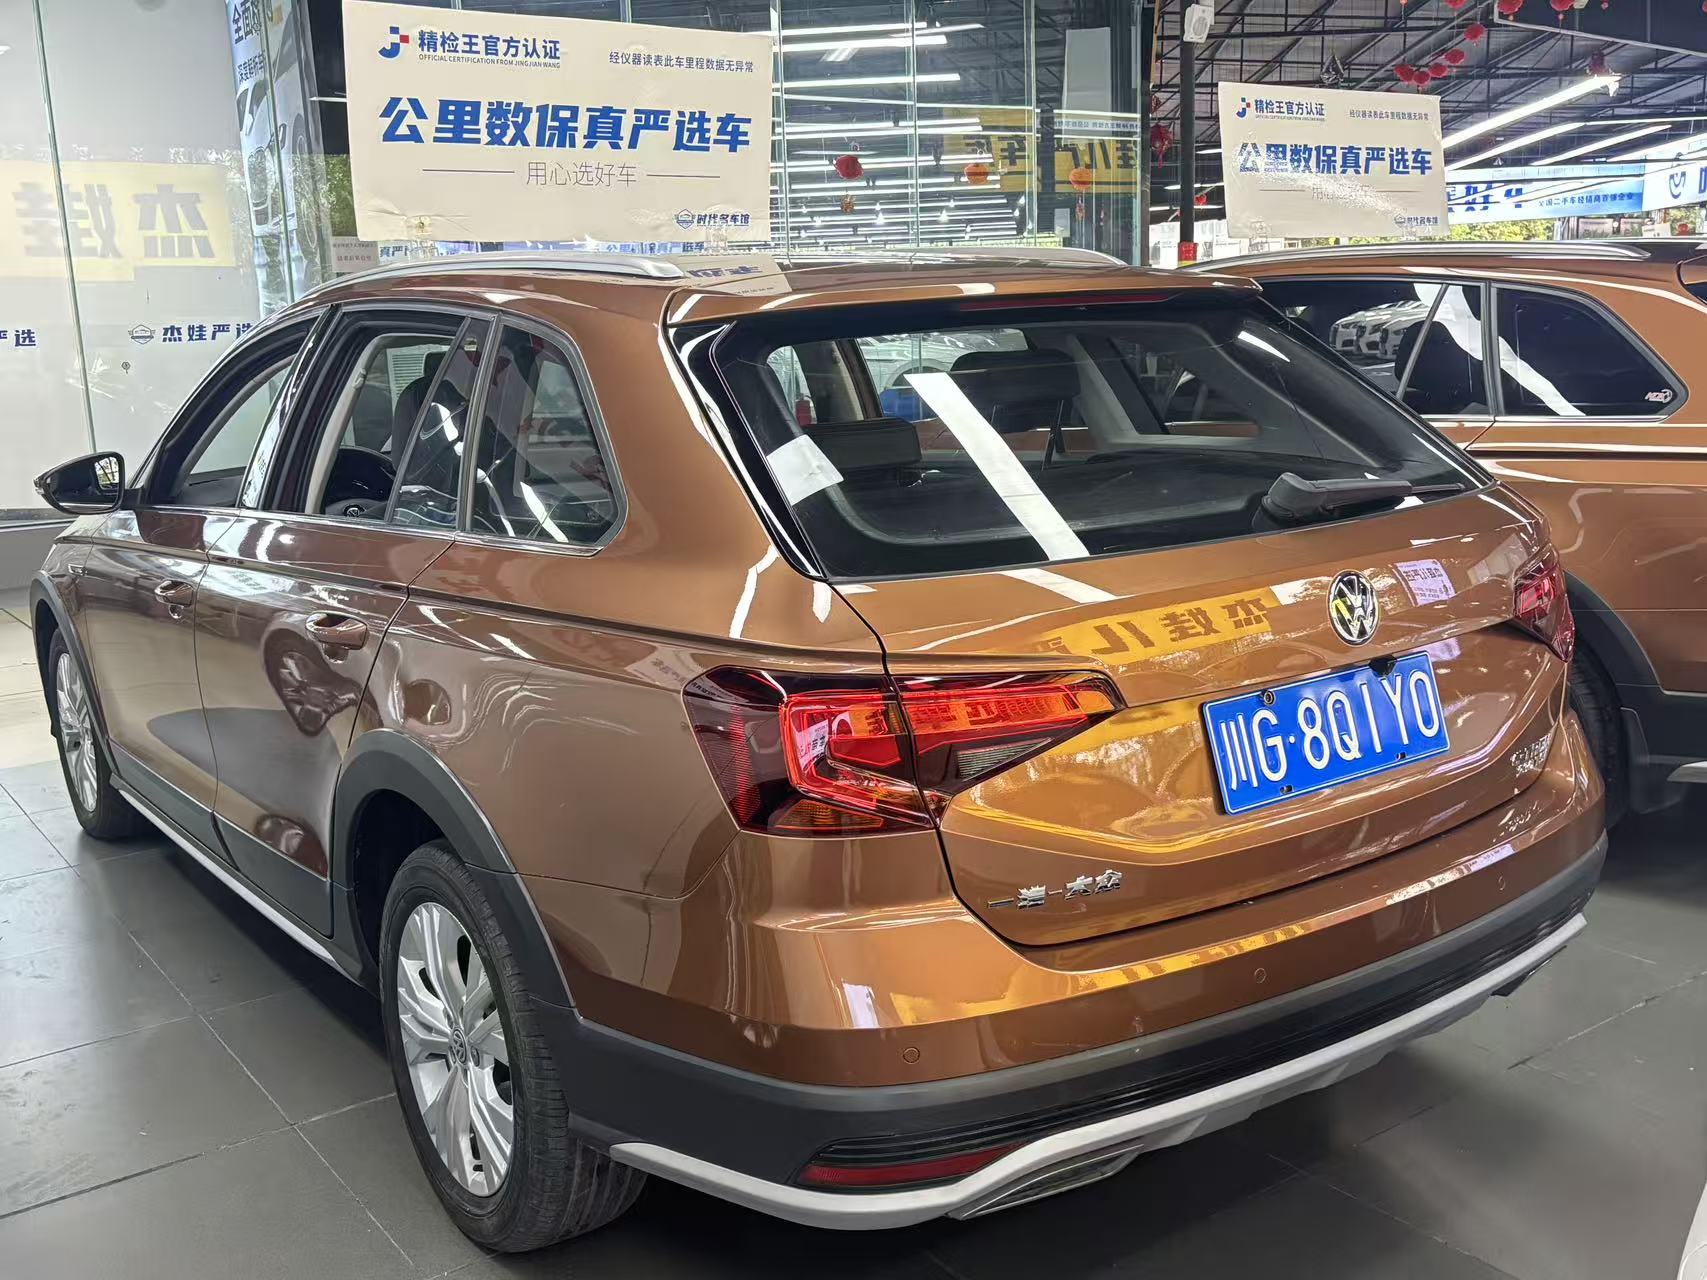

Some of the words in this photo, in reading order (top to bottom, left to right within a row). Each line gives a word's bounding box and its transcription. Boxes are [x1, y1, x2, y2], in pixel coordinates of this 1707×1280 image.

[418, 30, 561, 60] 精检王官方认证
[419, 54, 447, 62] OFFICIAL
[449, 56, 495, 65] CERTIFICATION
[609, 52, 754, 73] 经仪器读表此车里程数据无异常
[1254, 98, 1325, 116] 精检王官方认证
[378, 96, 752, 153] 公里数保真严选车
[1238, 142, 1433, 176] 公里数保真严选车
[526, 161, 638, 187] 用心选好车
[696, 213, 750, 225] 时代名车馆
[1219, 669, 1440, 791] 川G·8Q1Y0
